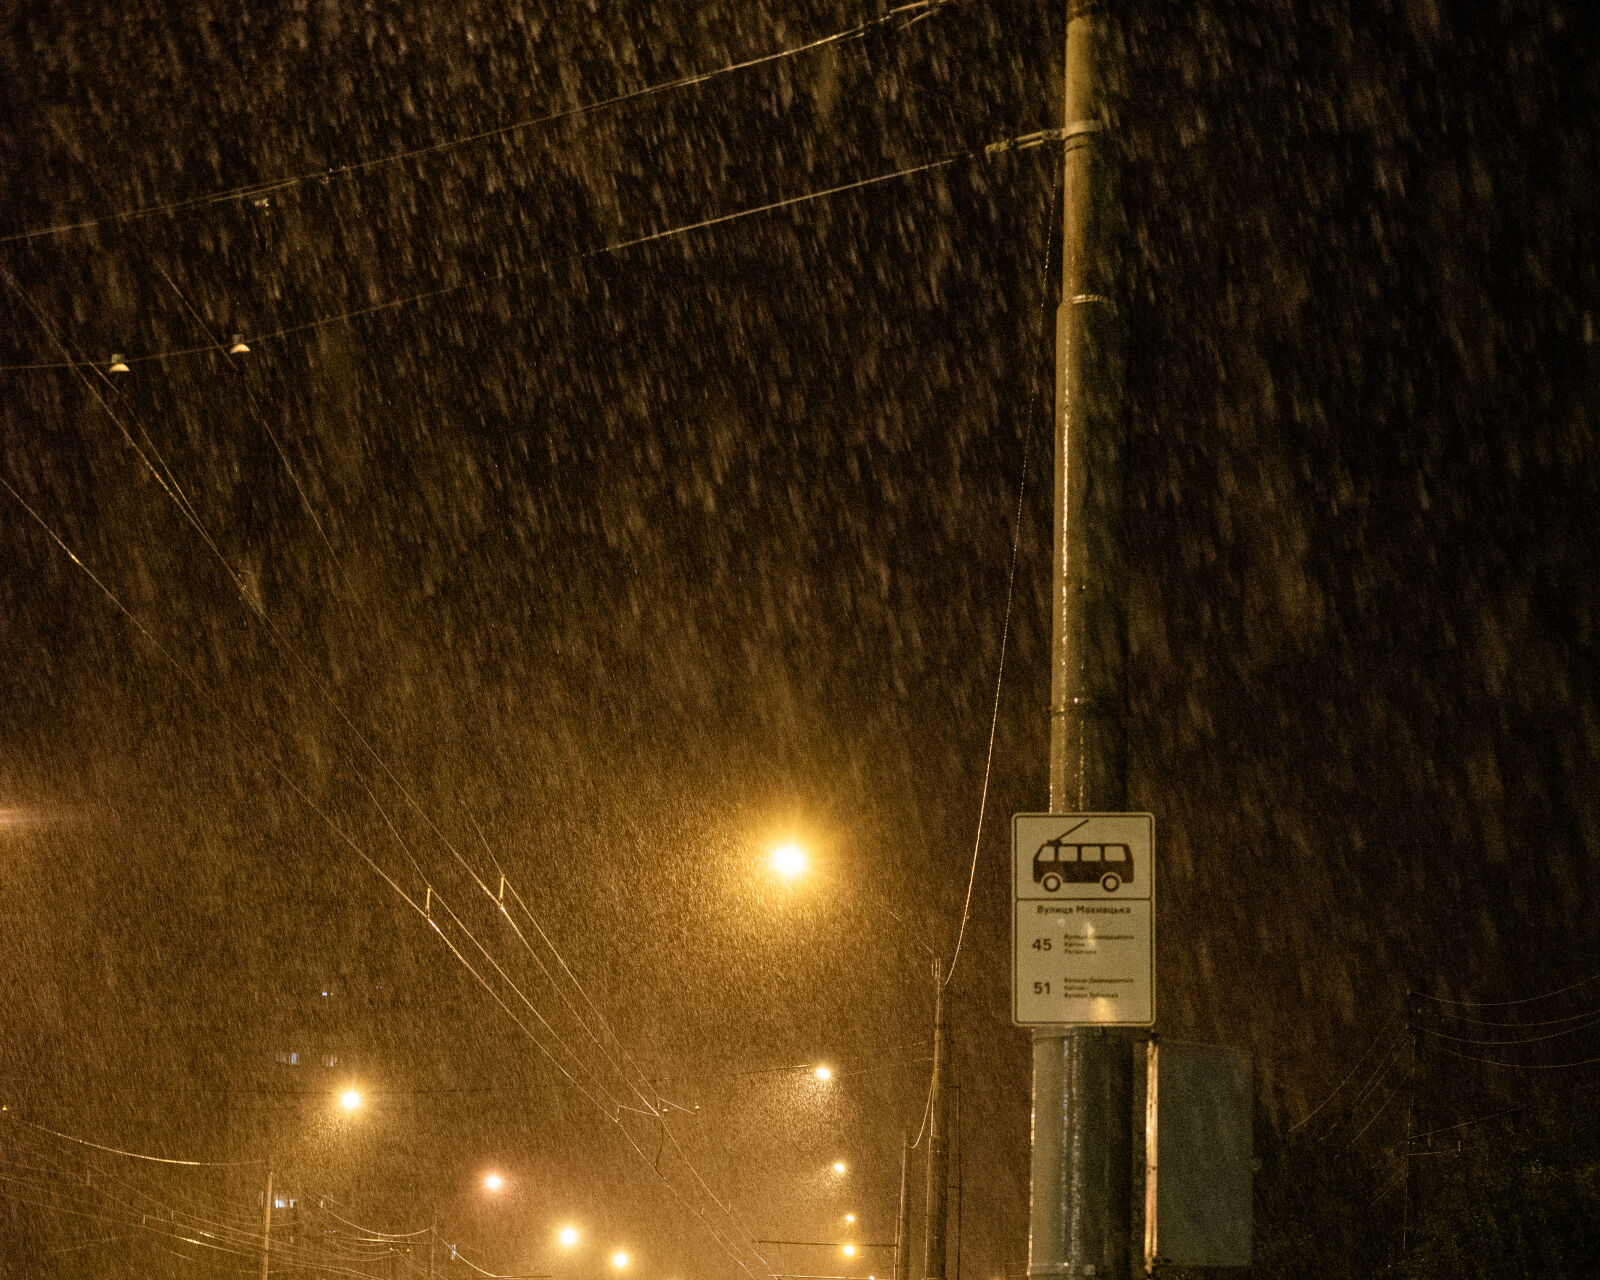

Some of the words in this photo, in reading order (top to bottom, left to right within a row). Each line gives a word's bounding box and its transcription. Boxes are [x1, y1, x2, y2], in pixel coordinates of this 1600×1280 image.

[1037, 905, 1073, 915] Вулиця
[1031, 938, 1052, 951] 45
[1033, 981, 1051, 994] 51
